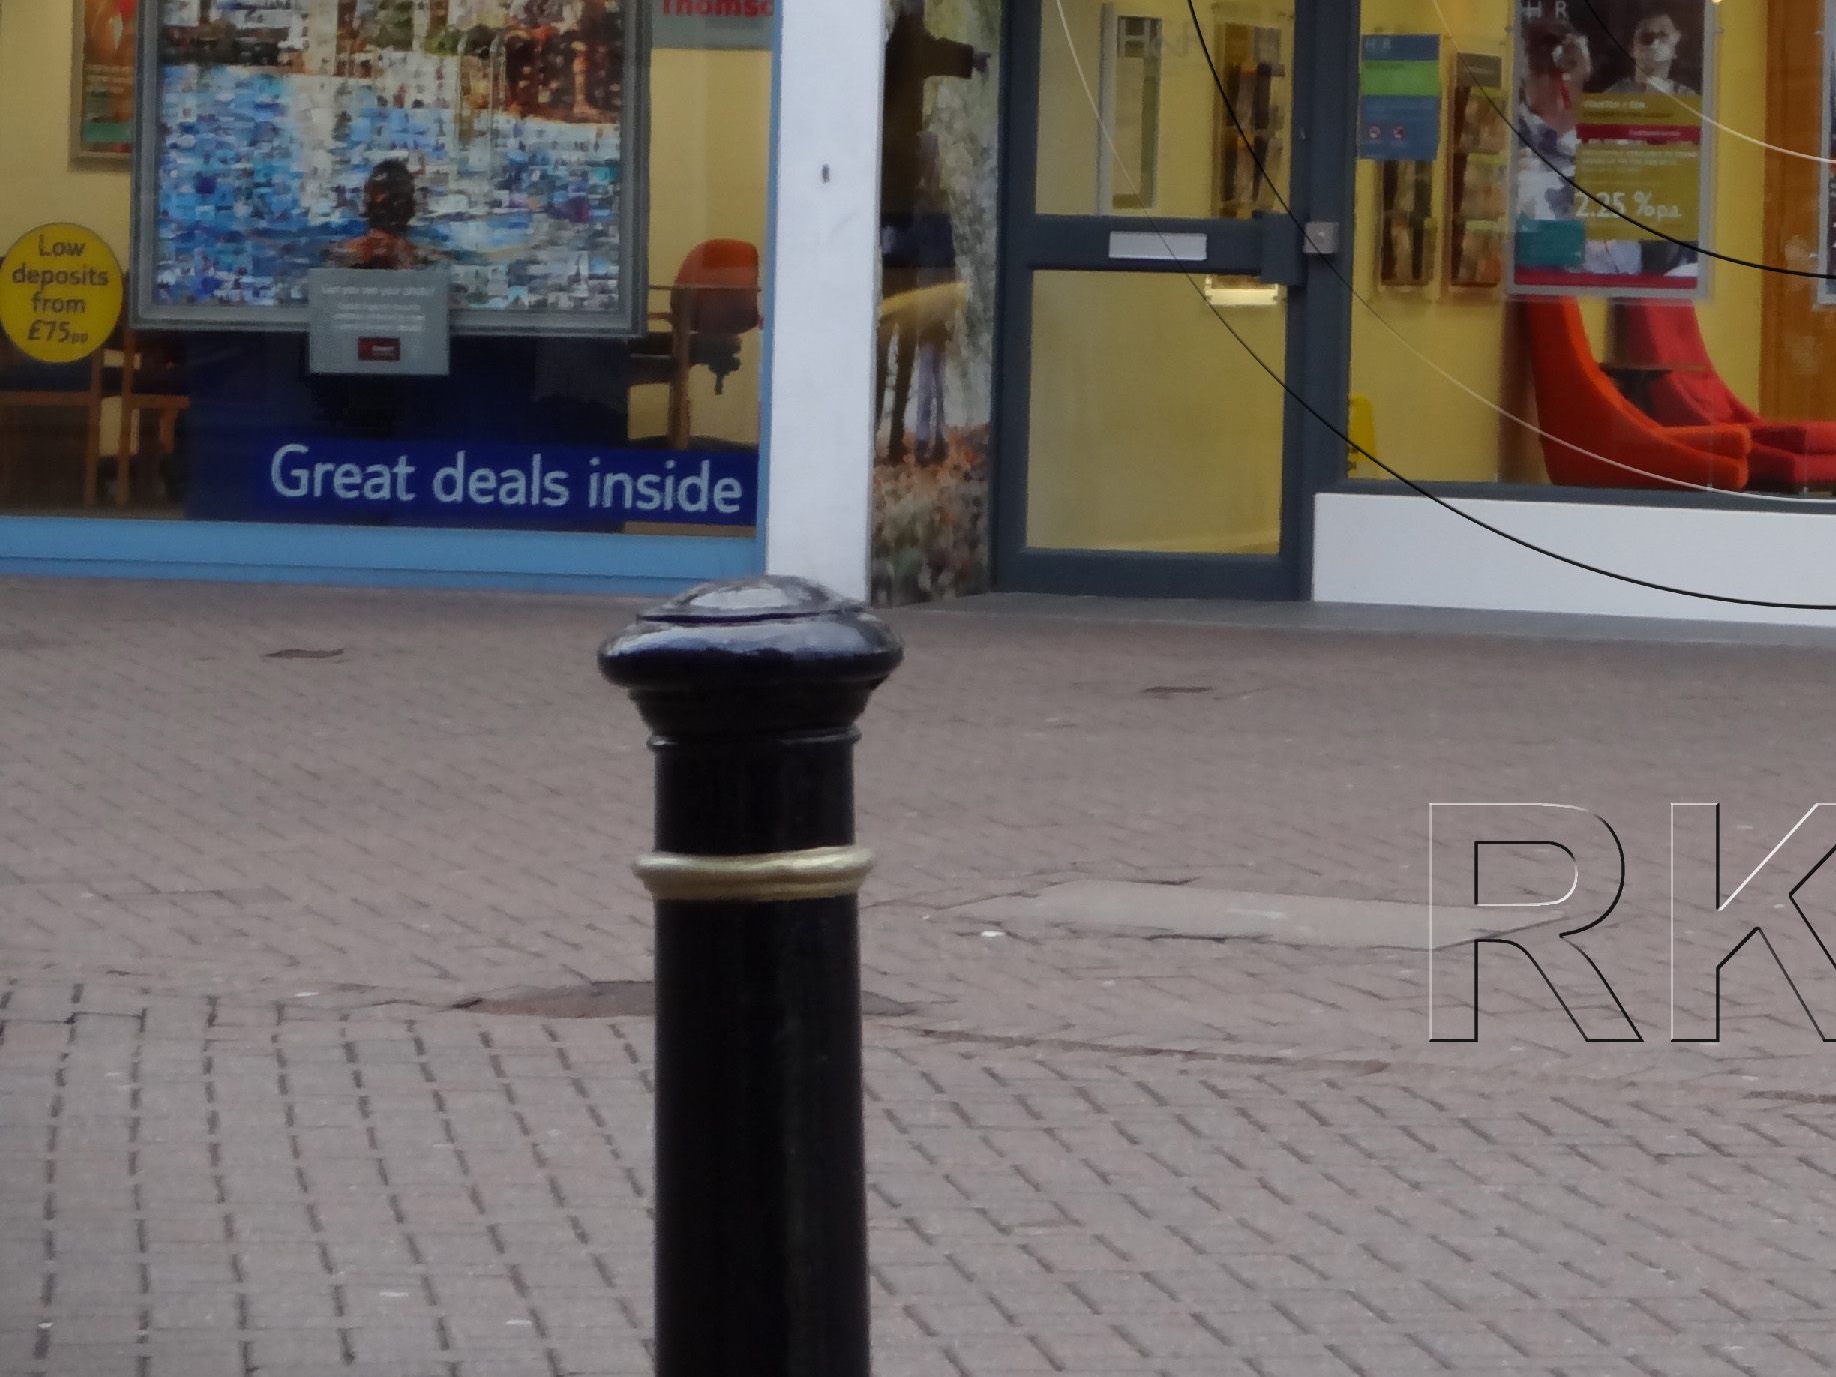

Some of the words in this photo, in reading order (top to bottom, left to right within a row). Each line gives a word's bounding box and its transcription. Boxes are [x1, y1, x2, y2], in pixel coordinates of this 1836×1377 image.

[38, 234, 86, 257] Low
[12, 262, 110, 289] deposits
[30, 290, 87, 314] from
[270, 442, 416, 501] Great
[432, 450, 569, 507] deals
[588, 457, 743, 514] inside
